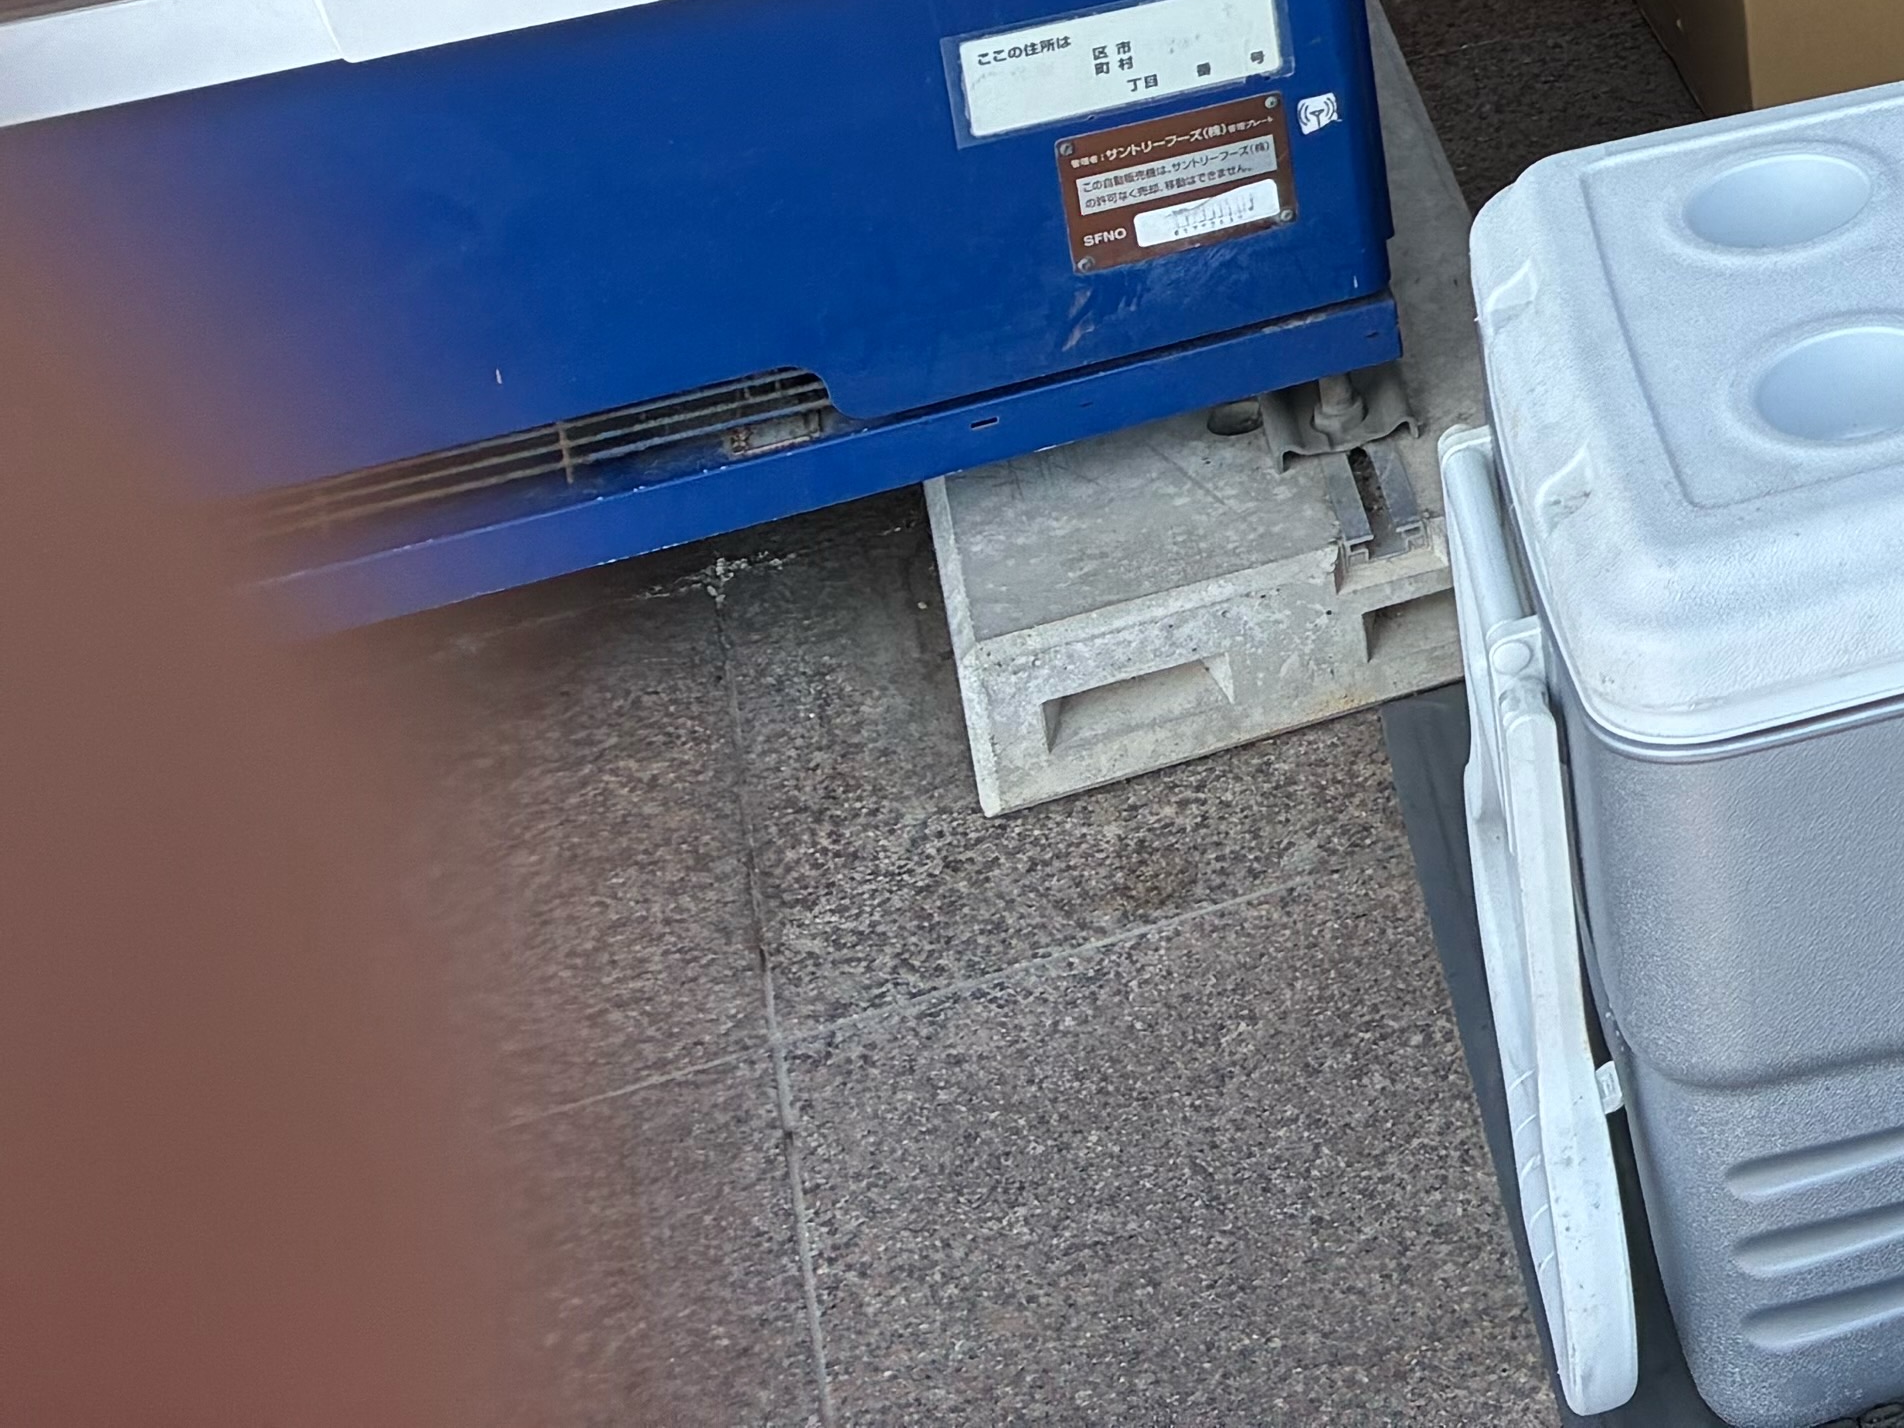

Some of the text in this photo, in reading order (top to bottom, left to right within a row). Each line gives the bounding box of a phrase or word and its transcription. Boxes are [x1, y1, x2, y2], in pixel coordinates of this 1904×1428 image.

[977, 35, 1071, 66] ここの住所は
[1127, 74, 1158, 92] 丁目
[1083, 227, 1127, 246] SFNO
